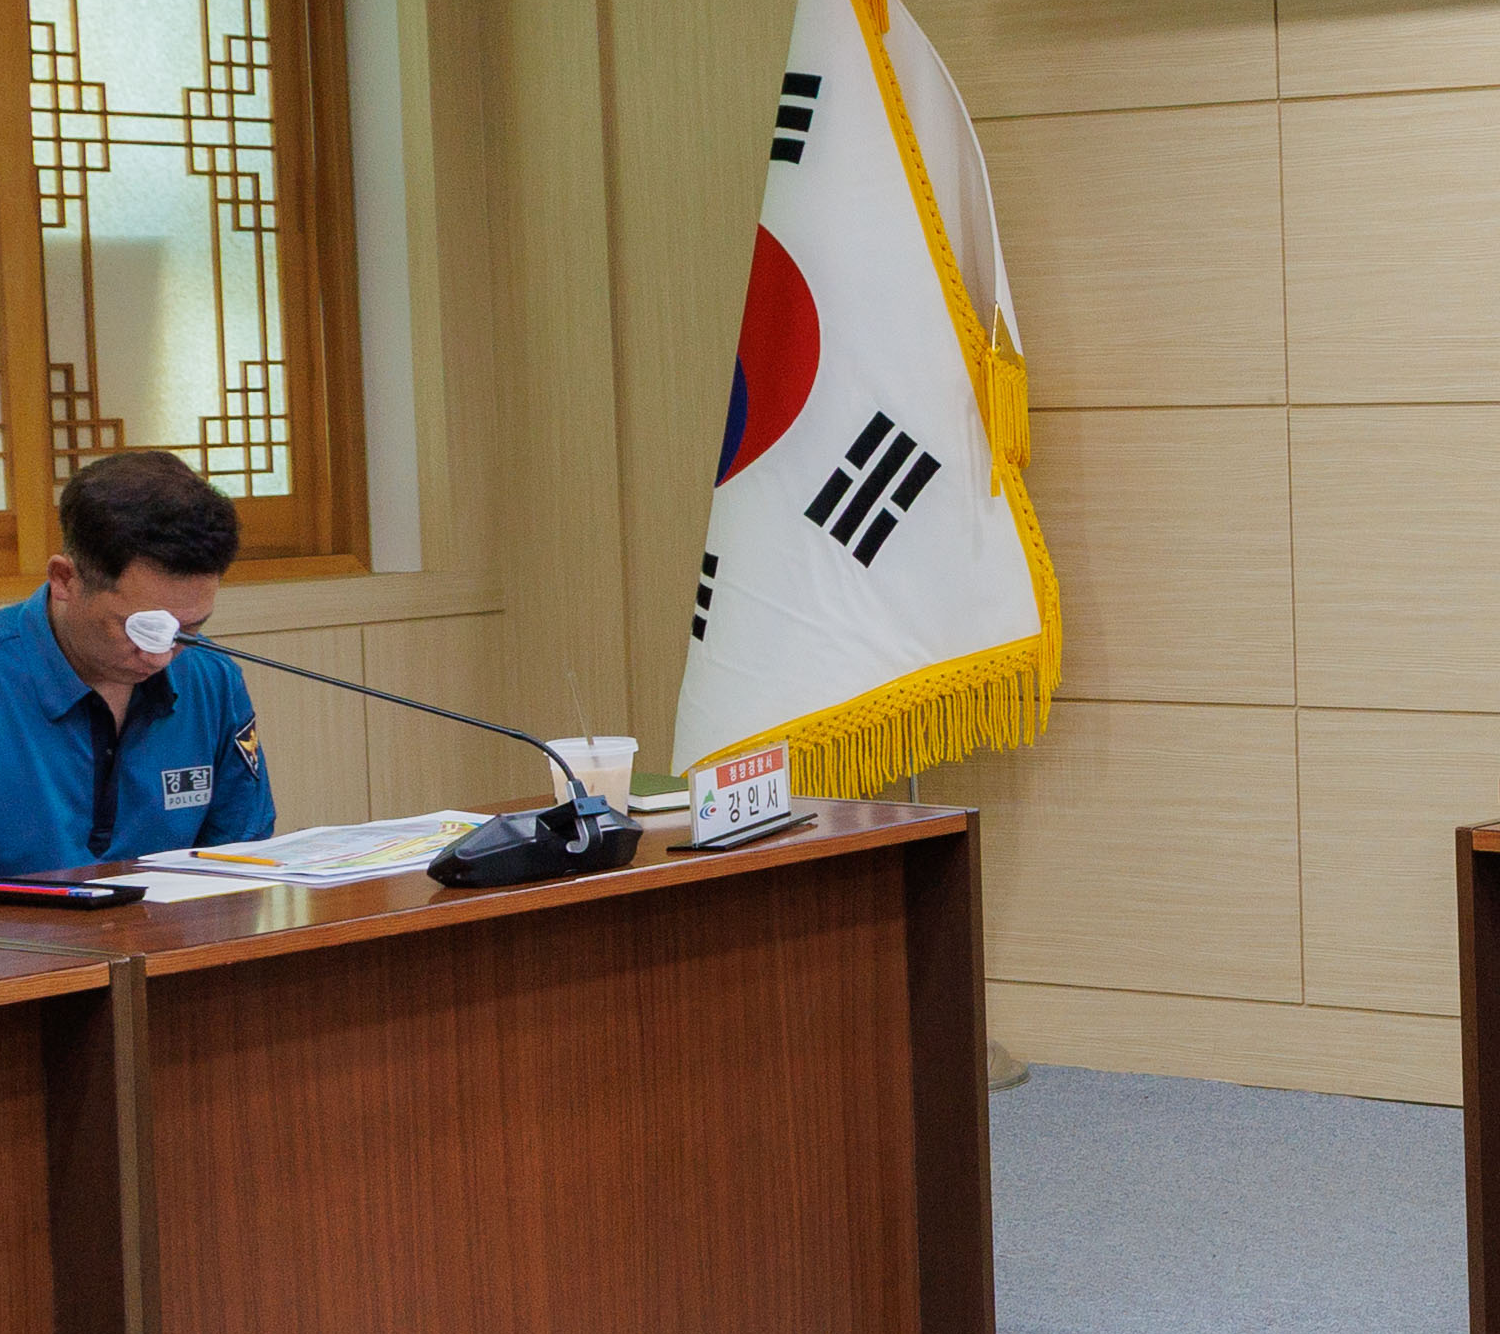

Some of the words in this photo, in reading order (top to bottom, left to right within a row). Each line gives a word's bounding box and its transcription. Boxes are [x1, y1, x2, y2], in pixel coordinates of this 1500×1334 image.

[729, 754, 773, 782] 청양경찰서
[167, 769, 209, 793] 경찰
[169, 793, 208, 806] POLICE
